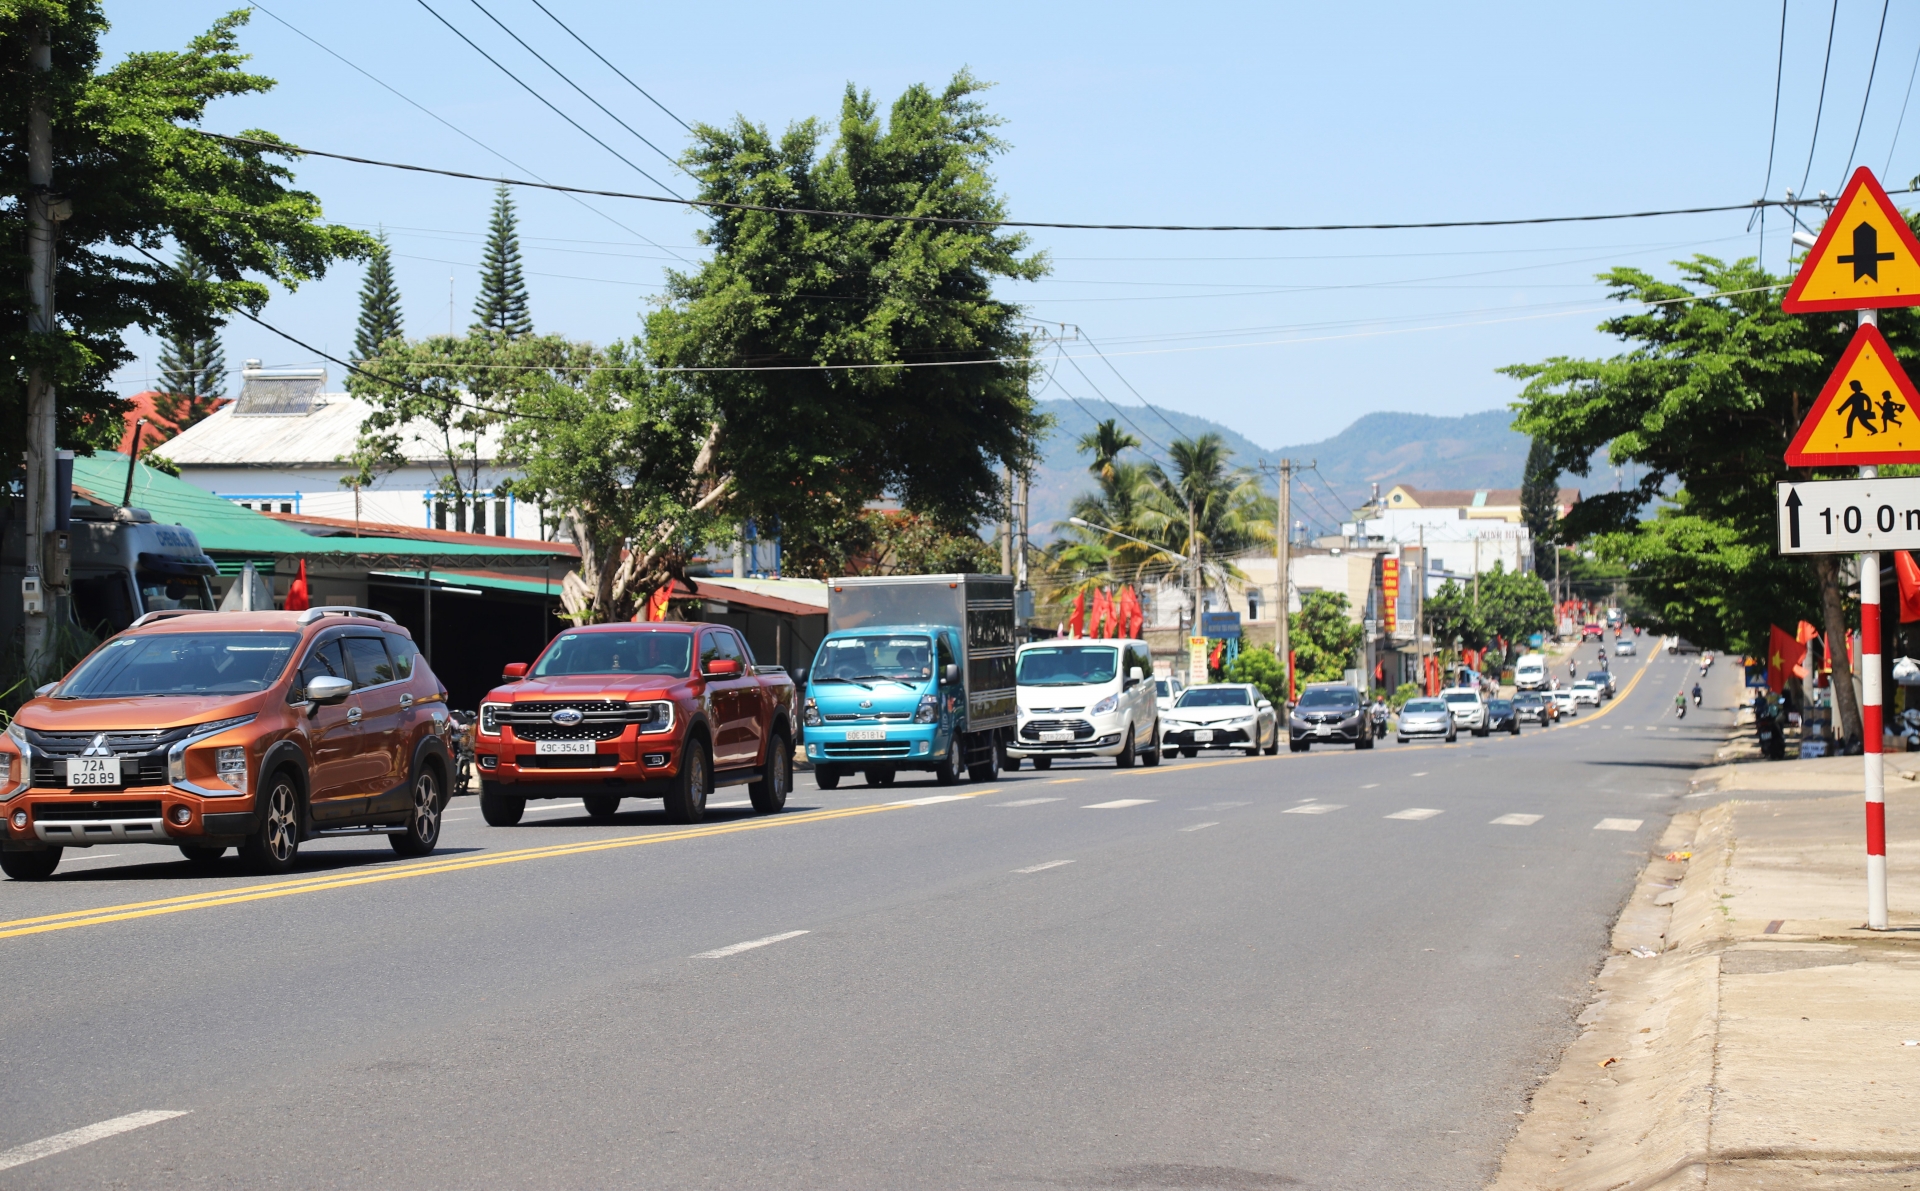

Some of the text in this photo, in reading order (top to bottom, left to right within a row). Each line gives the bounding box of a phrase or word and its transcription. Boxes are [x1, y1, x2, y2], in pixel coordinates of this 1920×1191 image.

[541, 743, 590, 753] 49C-354.81
[82, 760, 105, 771] 72A
[73, 773, 115, 784] 628.89
